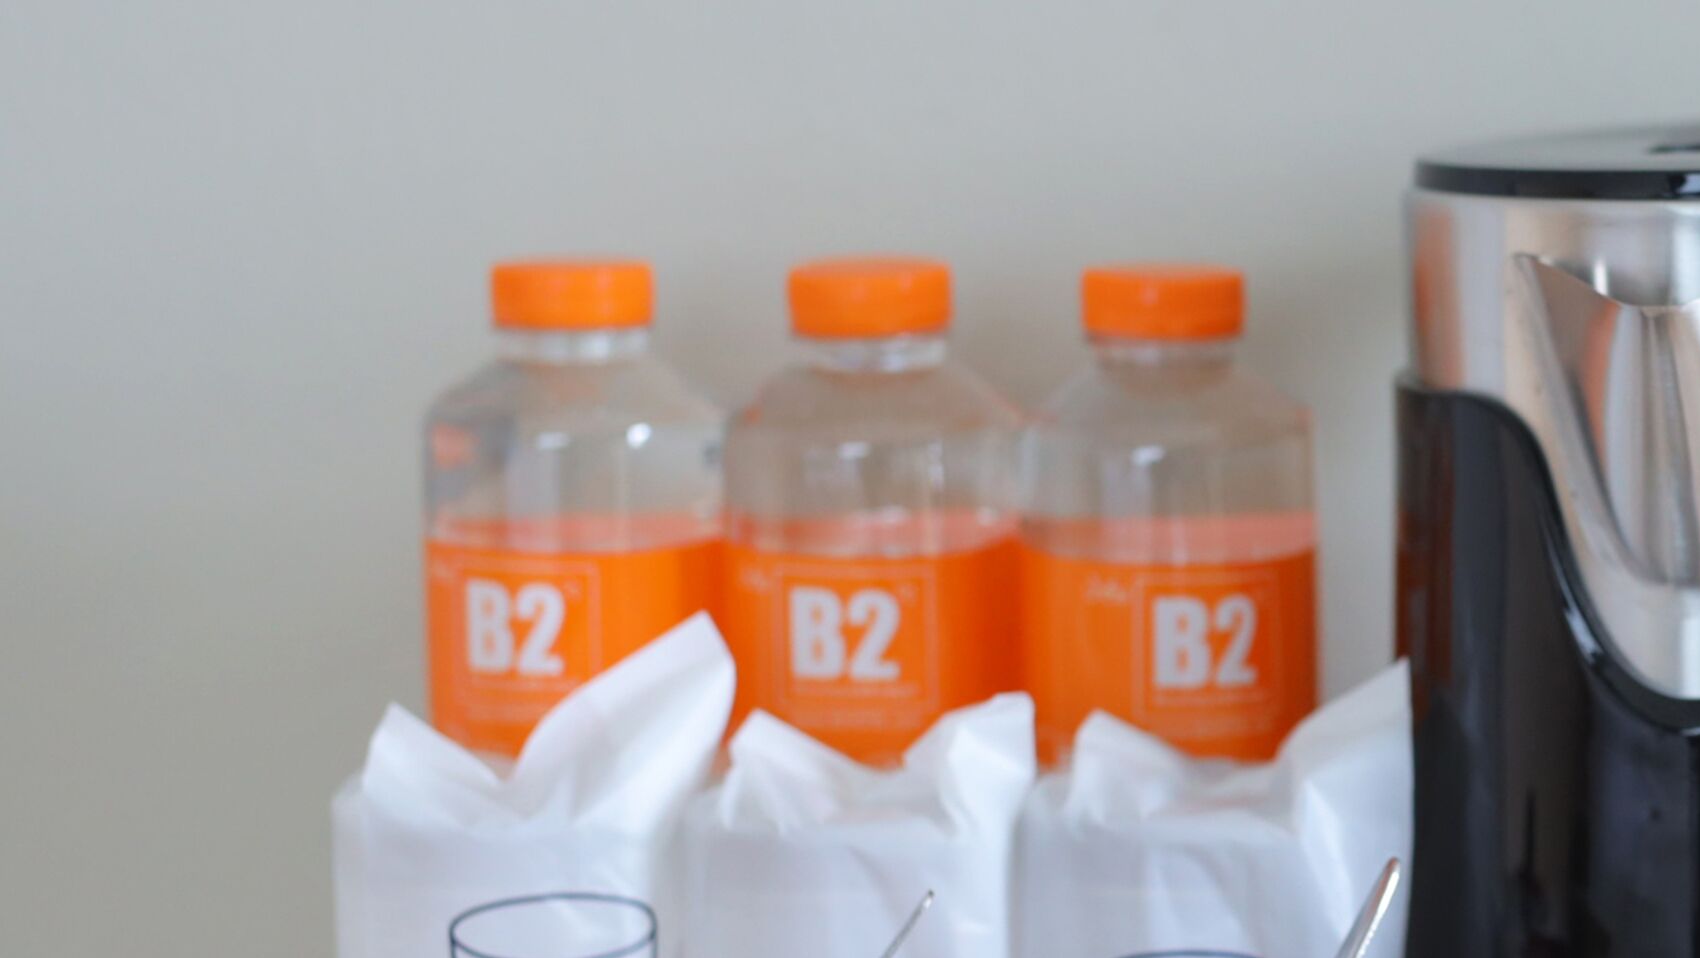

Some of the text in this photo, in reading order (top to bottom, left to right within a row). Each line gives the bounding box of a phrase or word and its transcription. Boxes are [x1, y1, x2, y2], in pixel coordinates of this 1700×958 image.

[466, 578, 564, 677] B2
[790, 585, 900, 680] B2
[1155, 593, 1256, 688] B2
